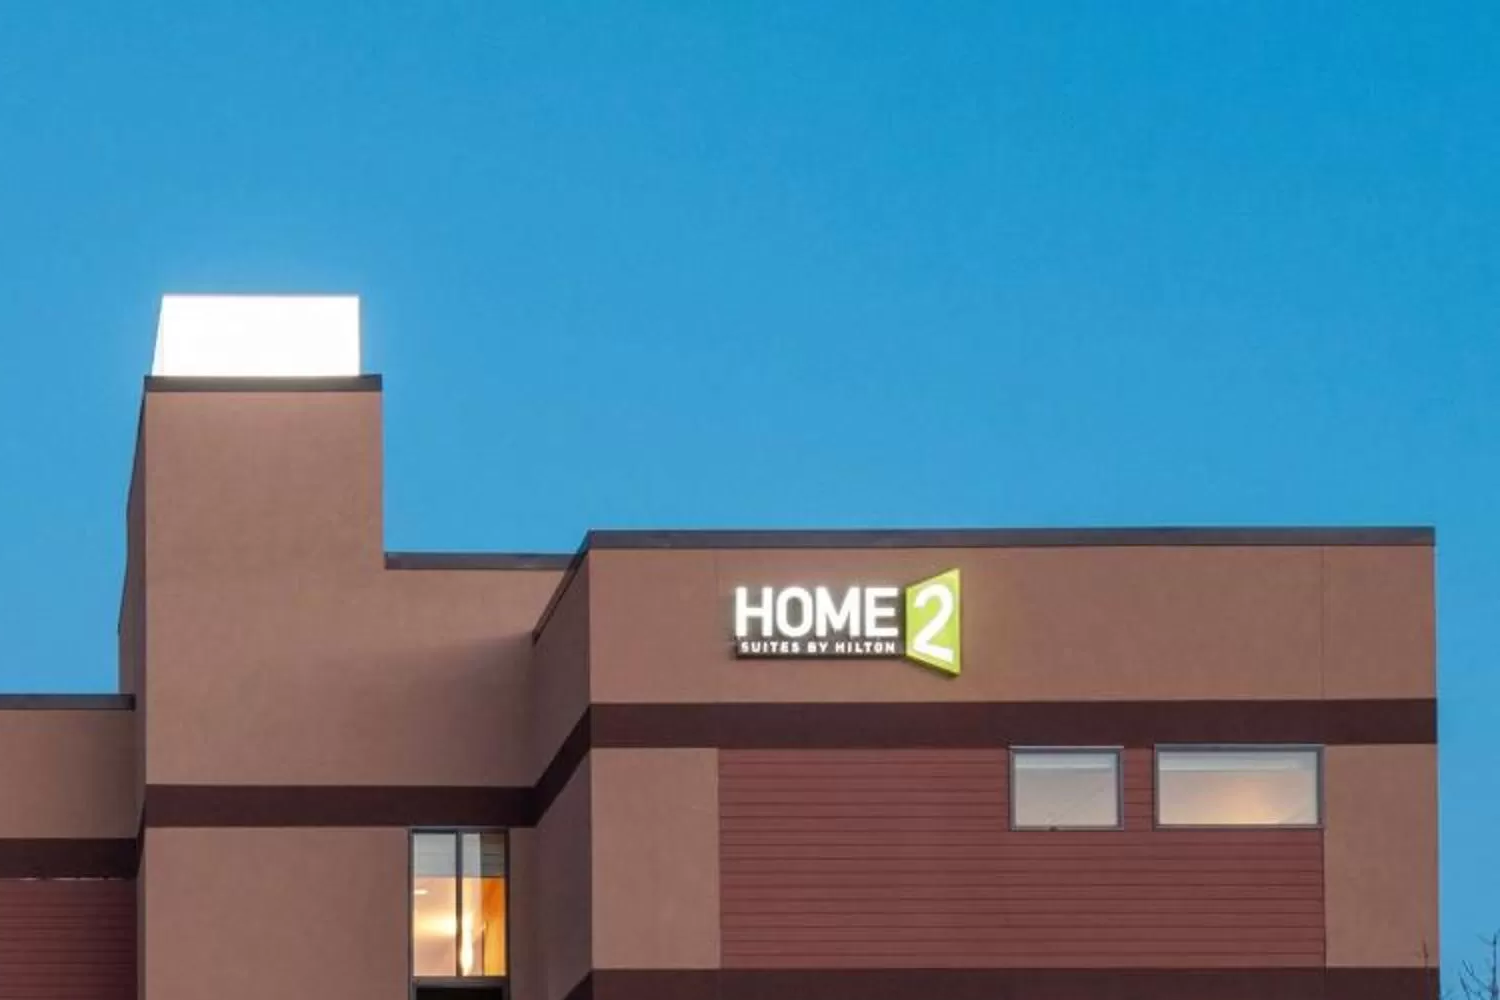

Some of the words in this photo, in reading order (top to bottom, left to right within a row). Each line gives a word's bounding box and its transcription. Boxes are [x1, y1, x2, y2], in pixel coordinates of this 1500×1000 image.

[735, 586, 899, 637] HOME
[912, 584, 954, 663] 2
[740, 640, 800, 653] SUITES
[807, 640, 829, 653] BY
[835, 640, 896, 653] HILTON
